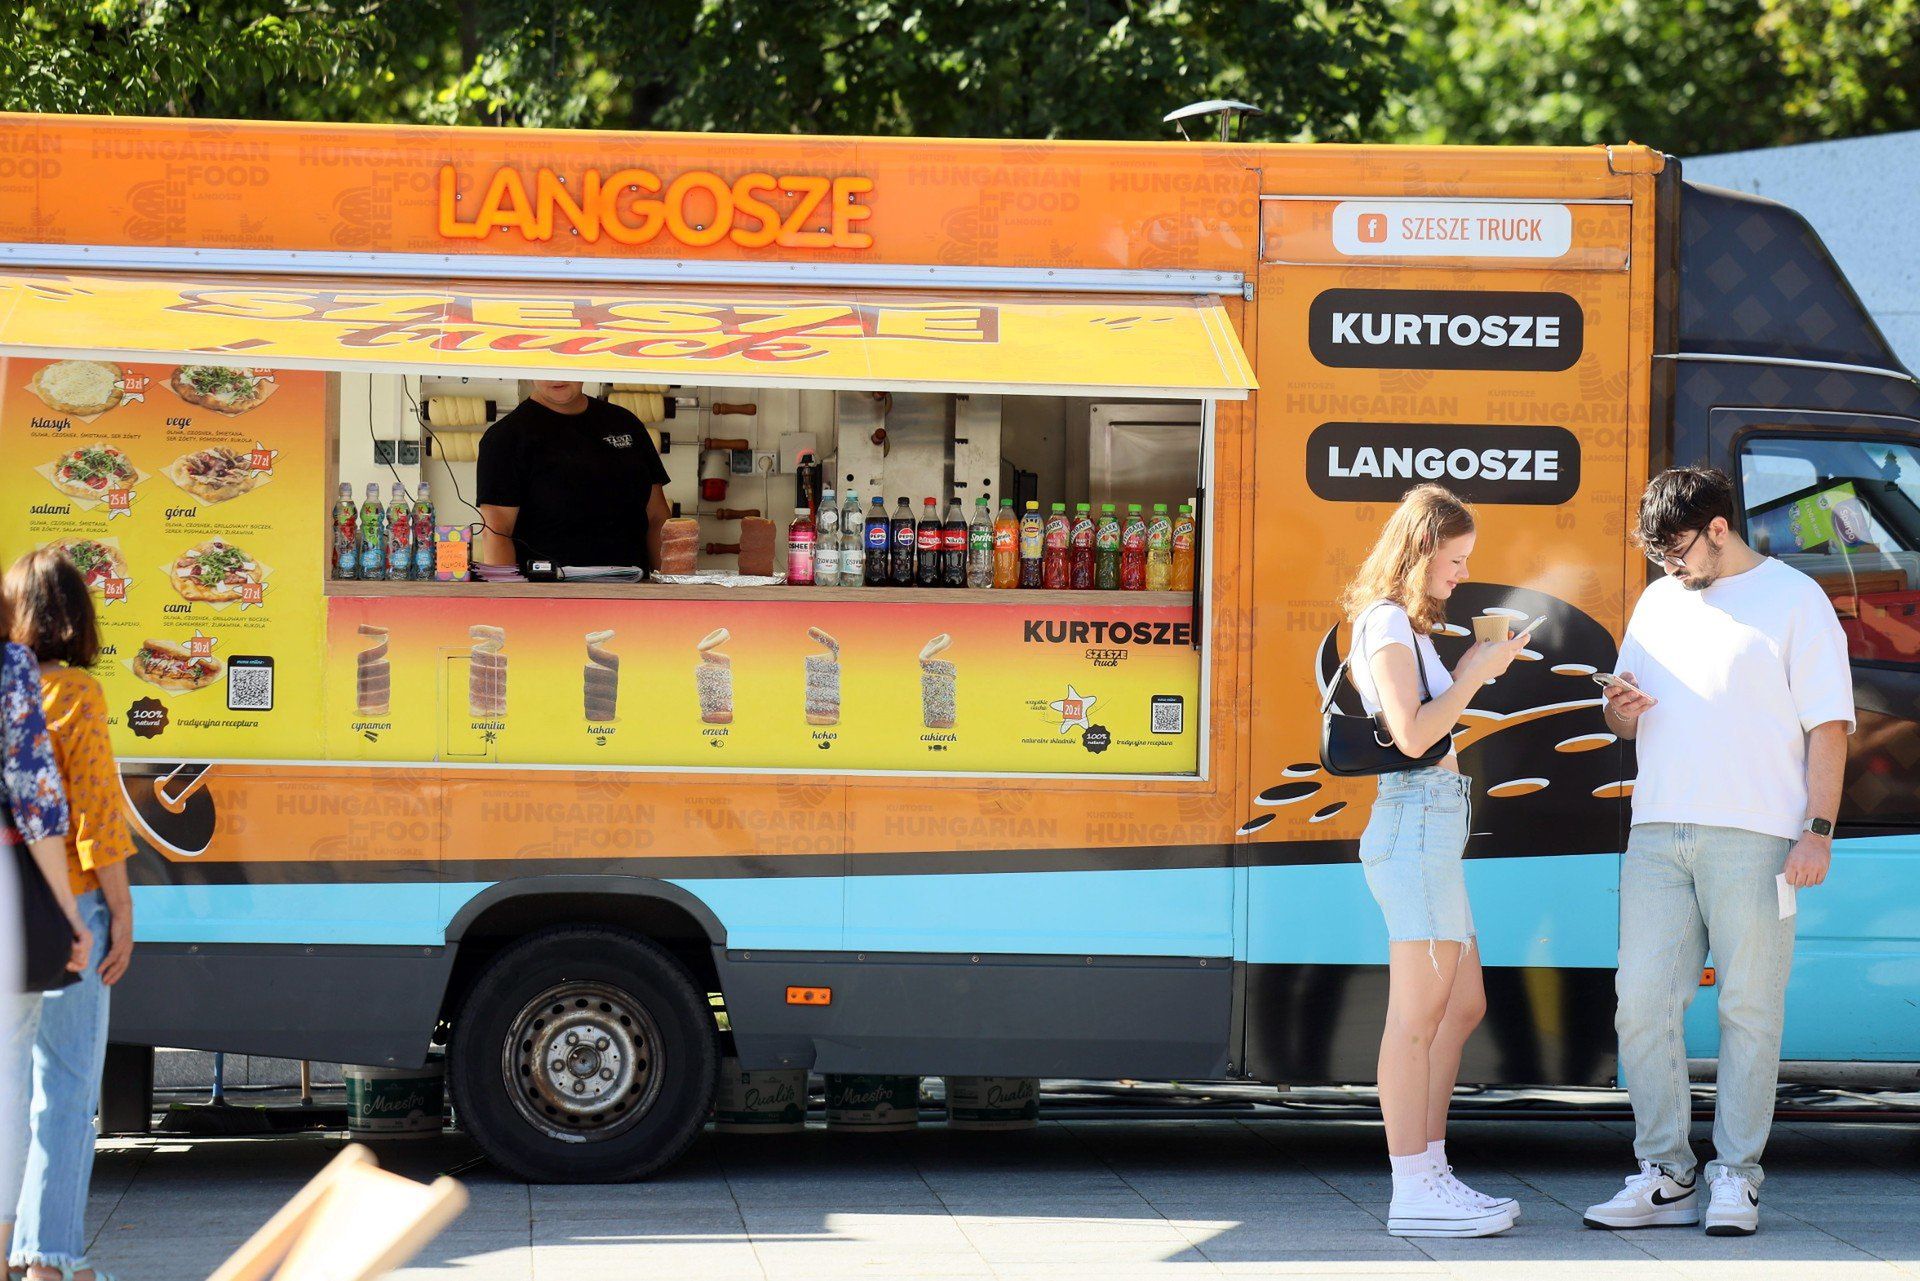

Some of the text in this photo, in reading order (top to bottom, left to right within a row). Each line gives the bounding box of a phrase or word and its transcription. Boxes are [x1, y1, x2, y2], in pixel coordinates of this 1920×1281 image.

[0, 132, 62, 155] RIAN
[91, 139, 271, 162] HUNGARIAN
[299, 146, 475, 168] HUNGARIAN
[0, 157, 62, 180] OOD
[187, 165, 271, 188] FOOD
[907, 164, 1081, 188] HUNGARIAN
[1108, 172, 1259, 196] HUNGARIA
[438, 164, 875, 249] LANGOSZE
[999, 191, 1080, 213] FOOD
[1199, 195, 1259, 220] FOO
[1401, 216, 1470, 241] SZESZE
[1478, 218, 1543, 242] TRUCK
[164, 287, 1000, 344] SZESZE
[336, 320, 829, 362] truck
[1331, 312, 1561, 348] KURTOSZE
[125, 378, 135, 389] 23
[1287, 381, 1336, 391] KURTOSZE
[1487, 390, 1537, 399] KURTOSZE
[1285, 393, 1458, 417] HUNGARIAN
[30, 416, 71, 432] klasyk
[166, 417, 192, 430] vege
[252, 456, 269, 467] 27 zł
[1328, 445, 1560, 481] LANGOSZE
[29, 503, 71, 515] salami
[110, 493, 127, 506] 25 zł
[164, 505, 197, 521] góral
[106, 584, 122, 595] 26 zł
[243, 588, 260, 600] 27 zł
[163, 602, 192, 613] cami
[1023, 619, 1191, 646] KURTOSZE
[193, 641, 209, 654] 30 zł
[1085, 649, 1128, 660] SZESZE
[1093, 657, 1119, 667] truck
[133, 709, 164, 719] 100%
[1064, 703, 1074, 716] 20
[177, 718, 260, 730] tradycyjna receptura
[351, 721, 392, 733] cynamon
[471, 719, 506, 731] wanilia
[586, 725, 616, 735] kakao
[702, 727, 729, 737] orzech
[811, 730, 838, 740] kokos
[275, 794, 452, 818] HUNGARIAN
[480, 801, 656, 824] HUNGARIAN
[368, 818, 452, 843] FOOD
[682, 807, 857, 832] HUNGARIAN
[884, 815, 1058, 839] HUNGARIAN
[574, 827, 656, 850] FOOD
[1085, 822, 1234, 844] HUNGARIA
[364, 1091, 424, 1116] Maestro
